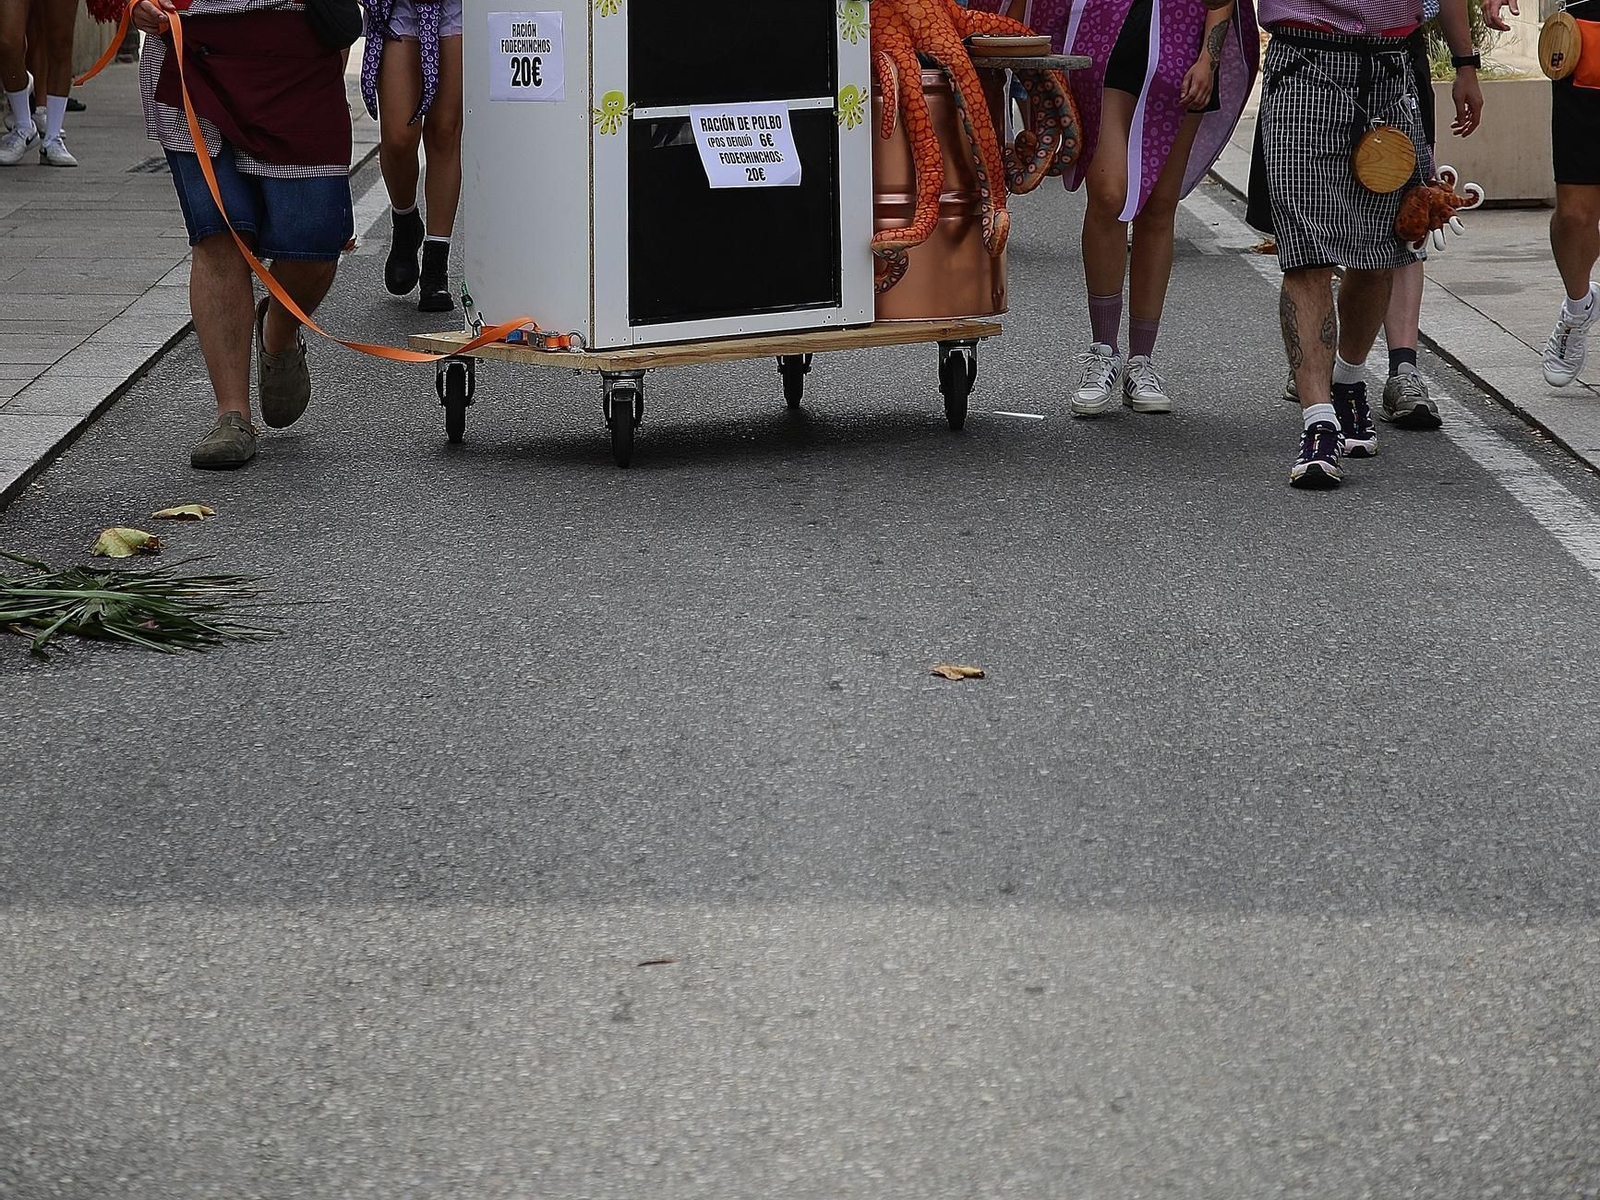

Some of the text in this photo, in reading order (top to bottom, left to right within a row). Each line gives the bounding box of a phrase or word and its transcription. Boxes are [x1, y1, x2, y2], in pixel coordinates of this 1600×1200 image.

[511, 20, 537, 38] RACIÓN
[500, 39, 551, 54] FODECHINCHOS
[510, 56, 543, 87] 20€
[700, 113, 782, 132] RACIÓN DE POLBO
[707, 136, 726, 148] (POS
[759, 133, 774, 147] 6€
[719, 150, 784, 165] FODECHINCHOS:
[745, 167, 766, 182] 20€
